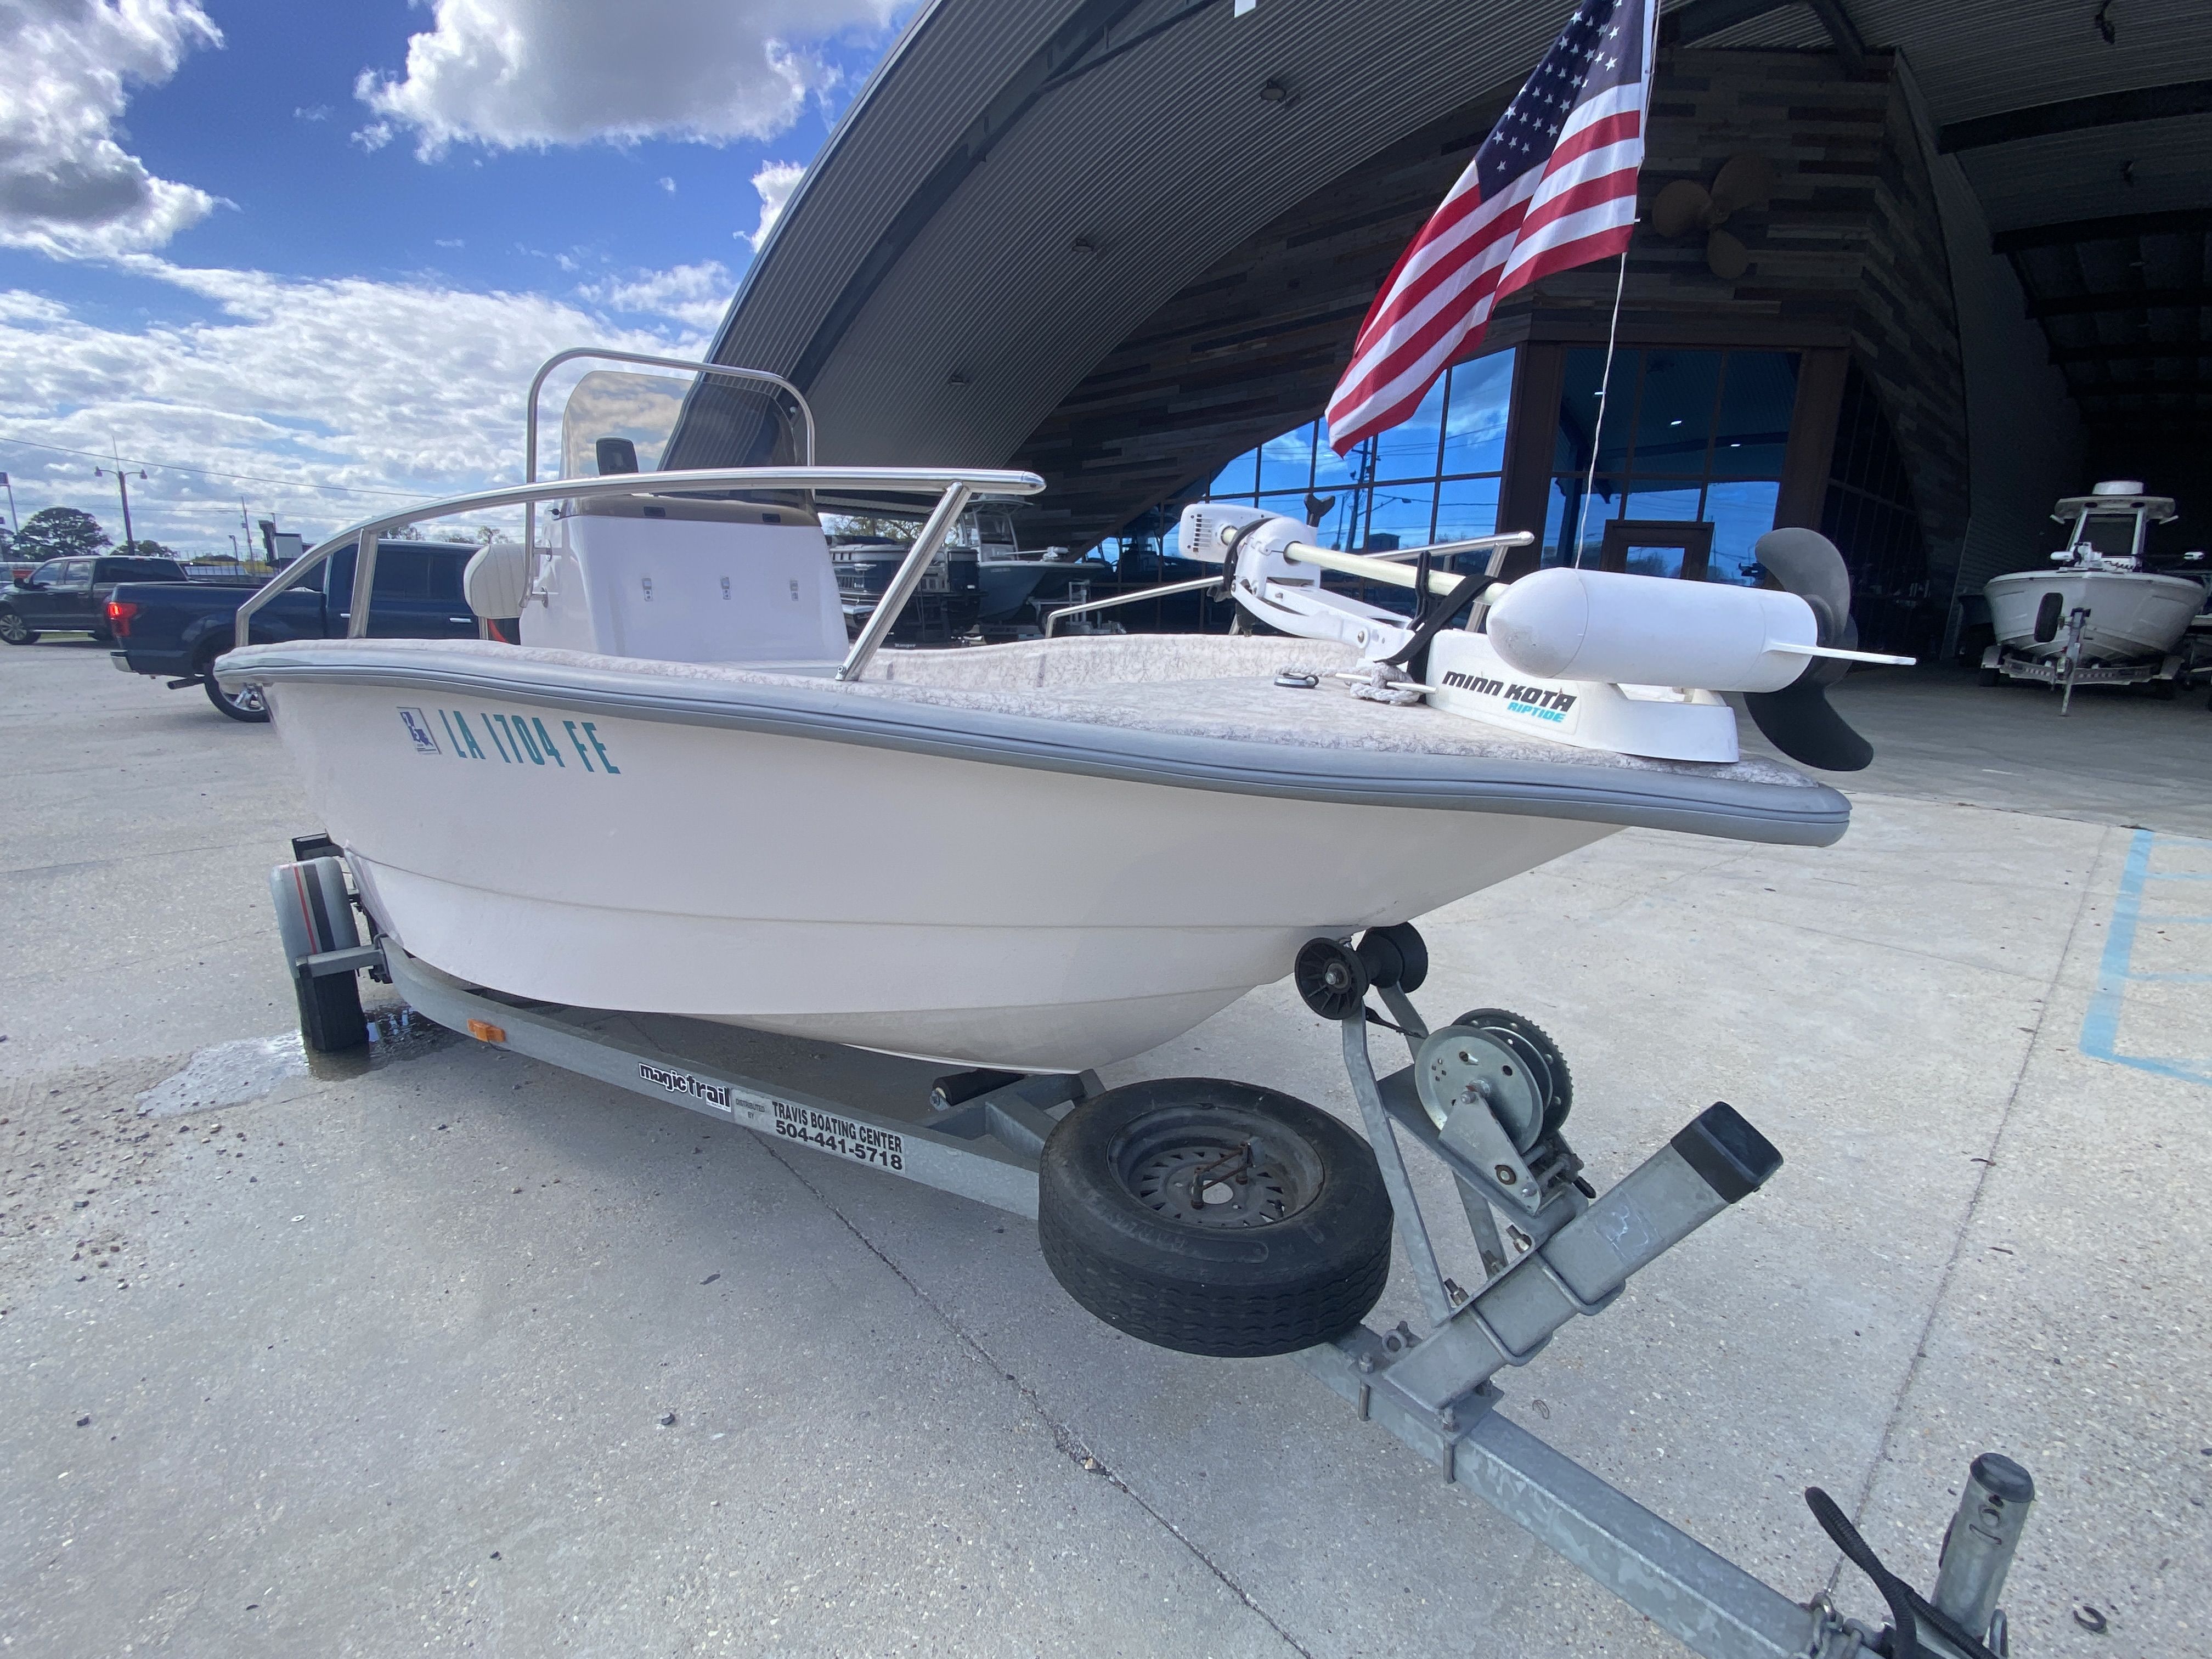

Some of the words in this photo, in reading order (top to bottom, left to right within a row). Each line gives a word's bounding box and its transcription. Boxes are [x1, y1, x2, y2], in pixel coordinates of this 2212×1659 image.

[1504, 684, 1577, 712] KOTA
[1507, 702, 1566, 723] RIPTIDE
[438, 709, 486, 759] LA
[481, 713, 566, 768] 1704
[562, 721, 621, 774] FE
[735, 1098, 765, 1113] DISTRIBUTED
[747, 1111, 754, 1119] BY
[772, 1101, 808, 1126] TRAVIS
[810, 1111, 856, 1140] BOATING
[859, 1126, 902, 1154] CENTER
[776, 1120, 902, 1170] 504-441-5718
